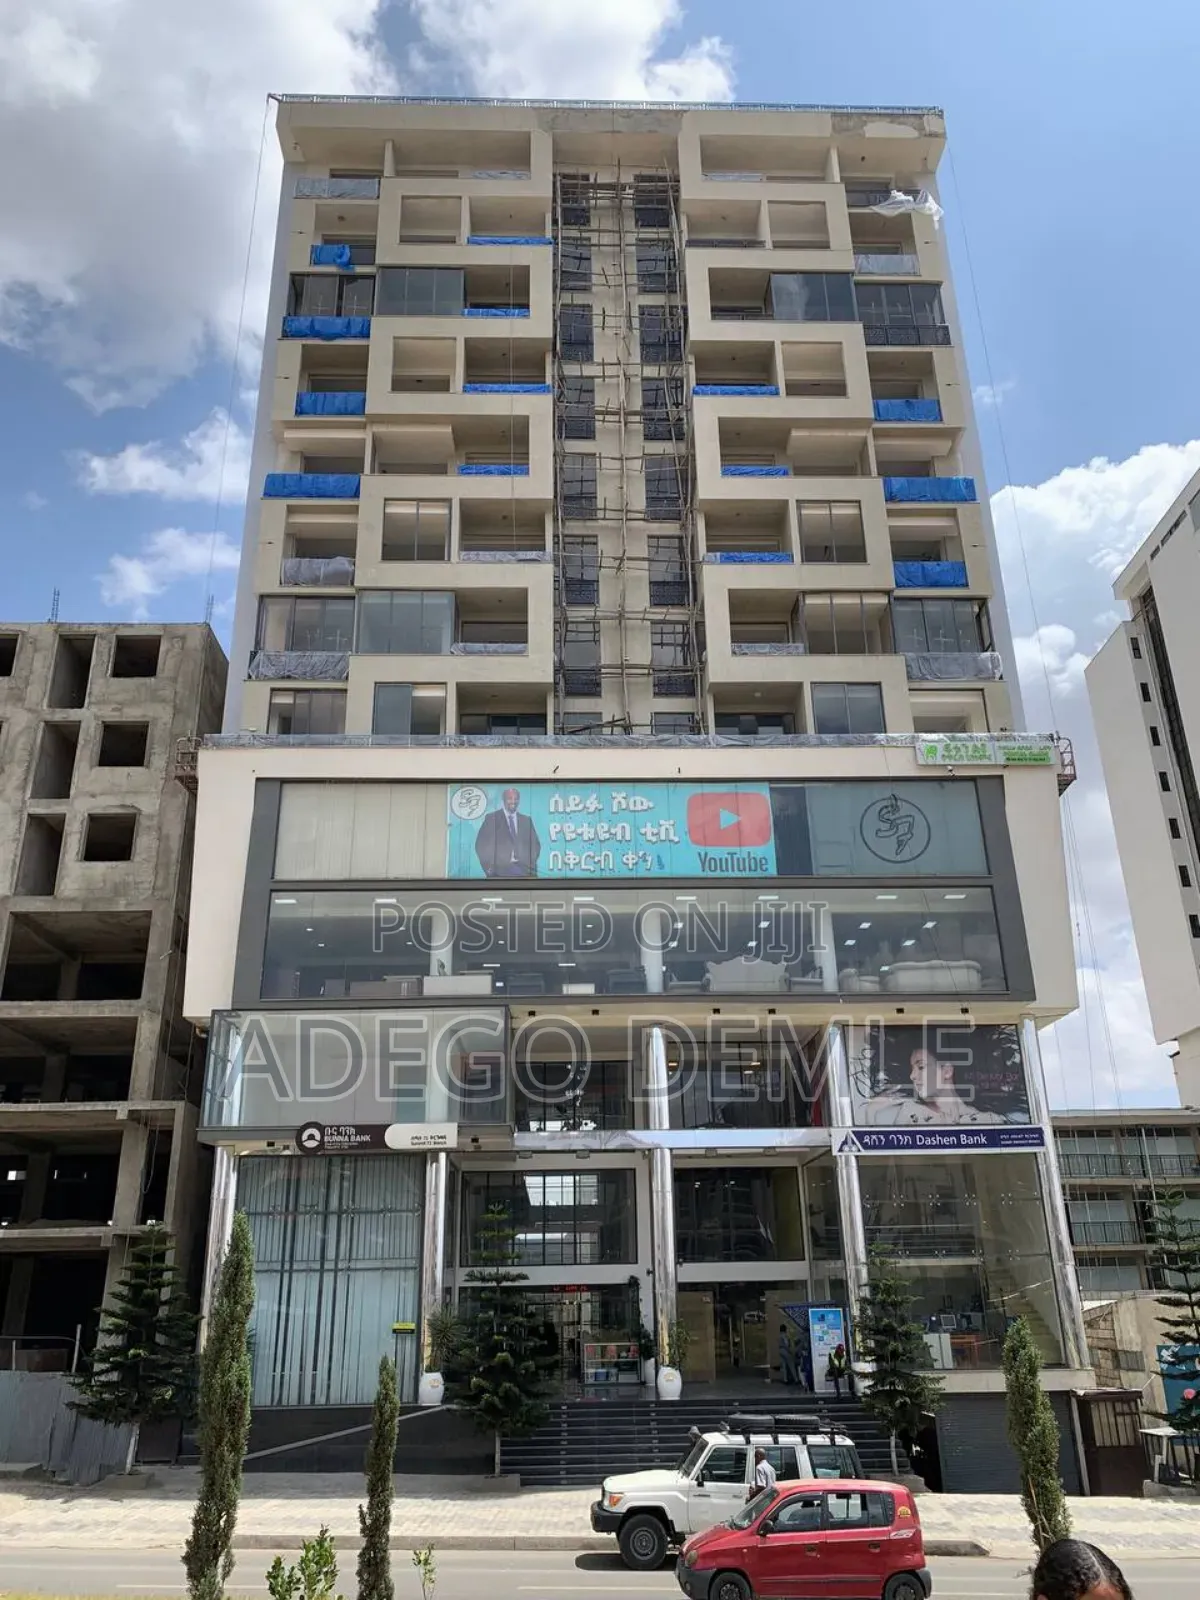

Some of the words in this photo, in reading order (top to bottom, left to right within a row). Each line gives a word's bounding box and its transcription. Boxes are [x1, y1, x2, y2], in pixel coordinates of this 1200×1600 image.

[549, 849, 615, 872] በቅርብ
[698, 851, 769, 873] YouTube
[889, 1134, 912, 1145] ባንክ
[915, 1134, 957, 1146] Dashen
[960, 1133, 988, 1145] Bank
